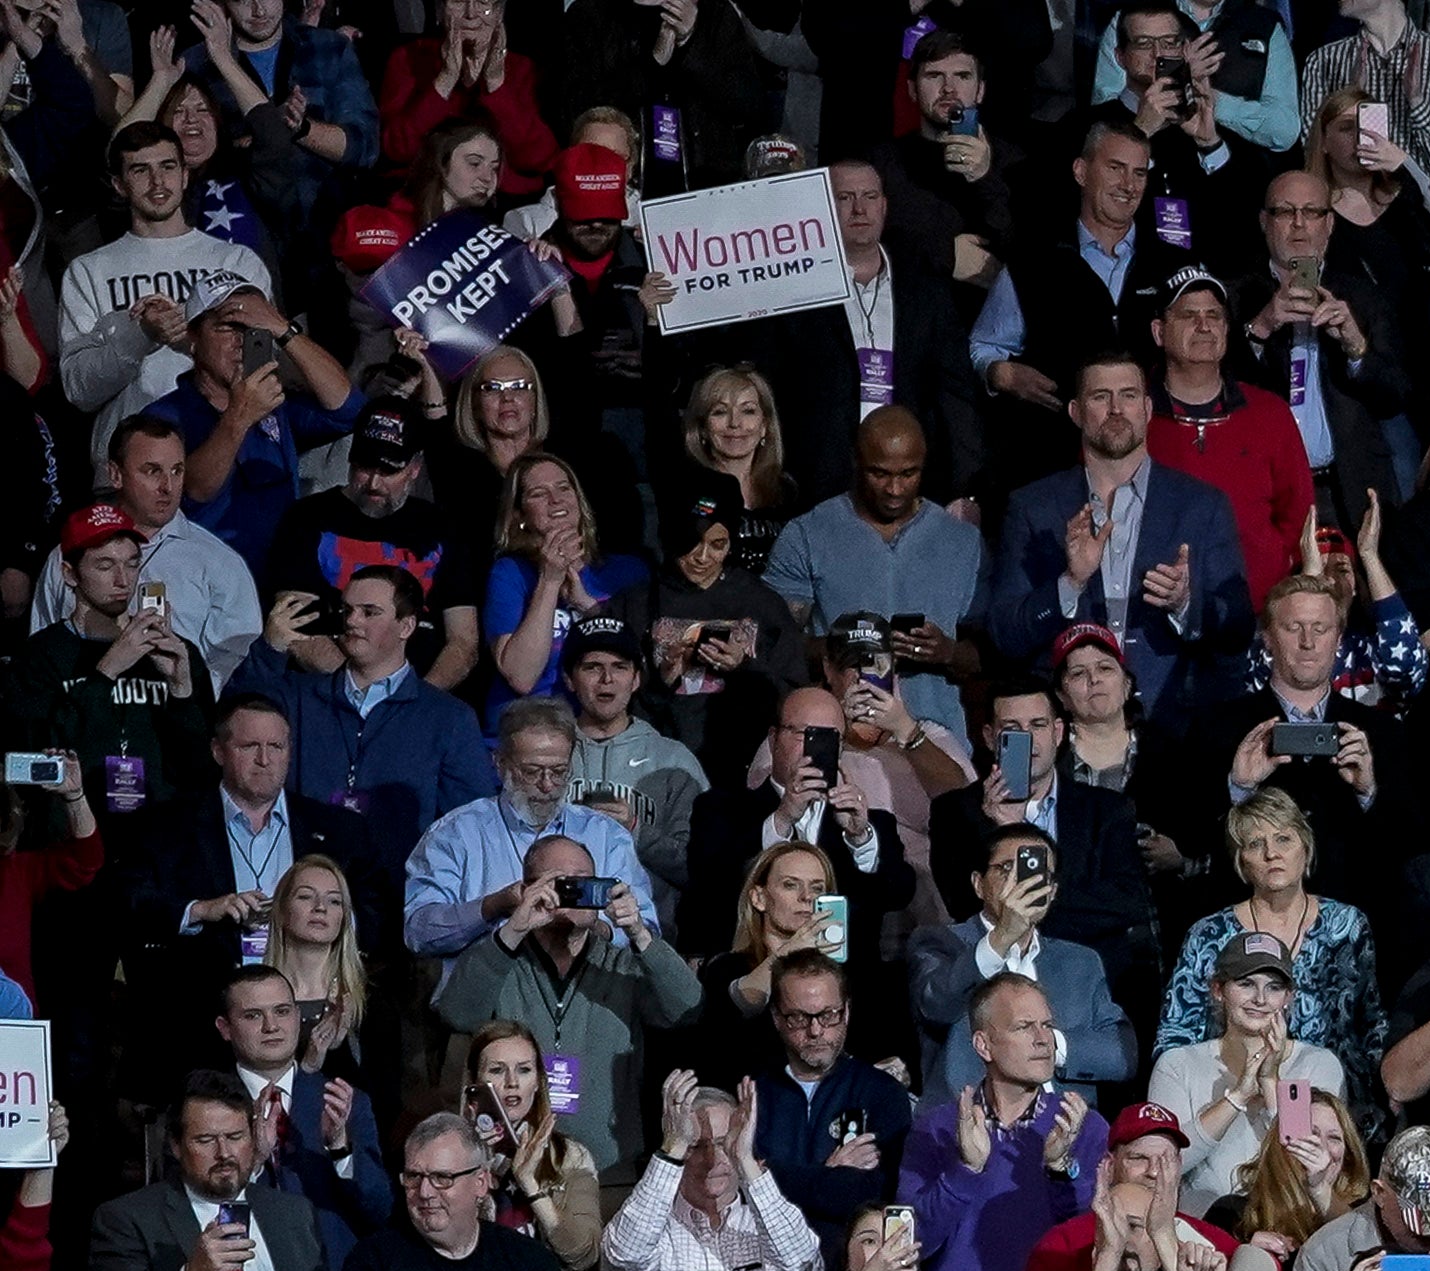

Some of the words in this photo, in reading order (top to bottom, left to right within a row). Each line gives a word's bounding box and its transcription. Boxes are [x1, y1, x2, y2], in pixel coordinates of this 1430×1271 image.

[392, 222, 511, 329] PROMISES
[658, 218, 825, 277] Women
[685, 267, 733, 295] FOR
[740, 256, 809, 285] TRUMP
[446, 259, 512, 325] KEPT
[846, 628, 883, 640] TRUMP
